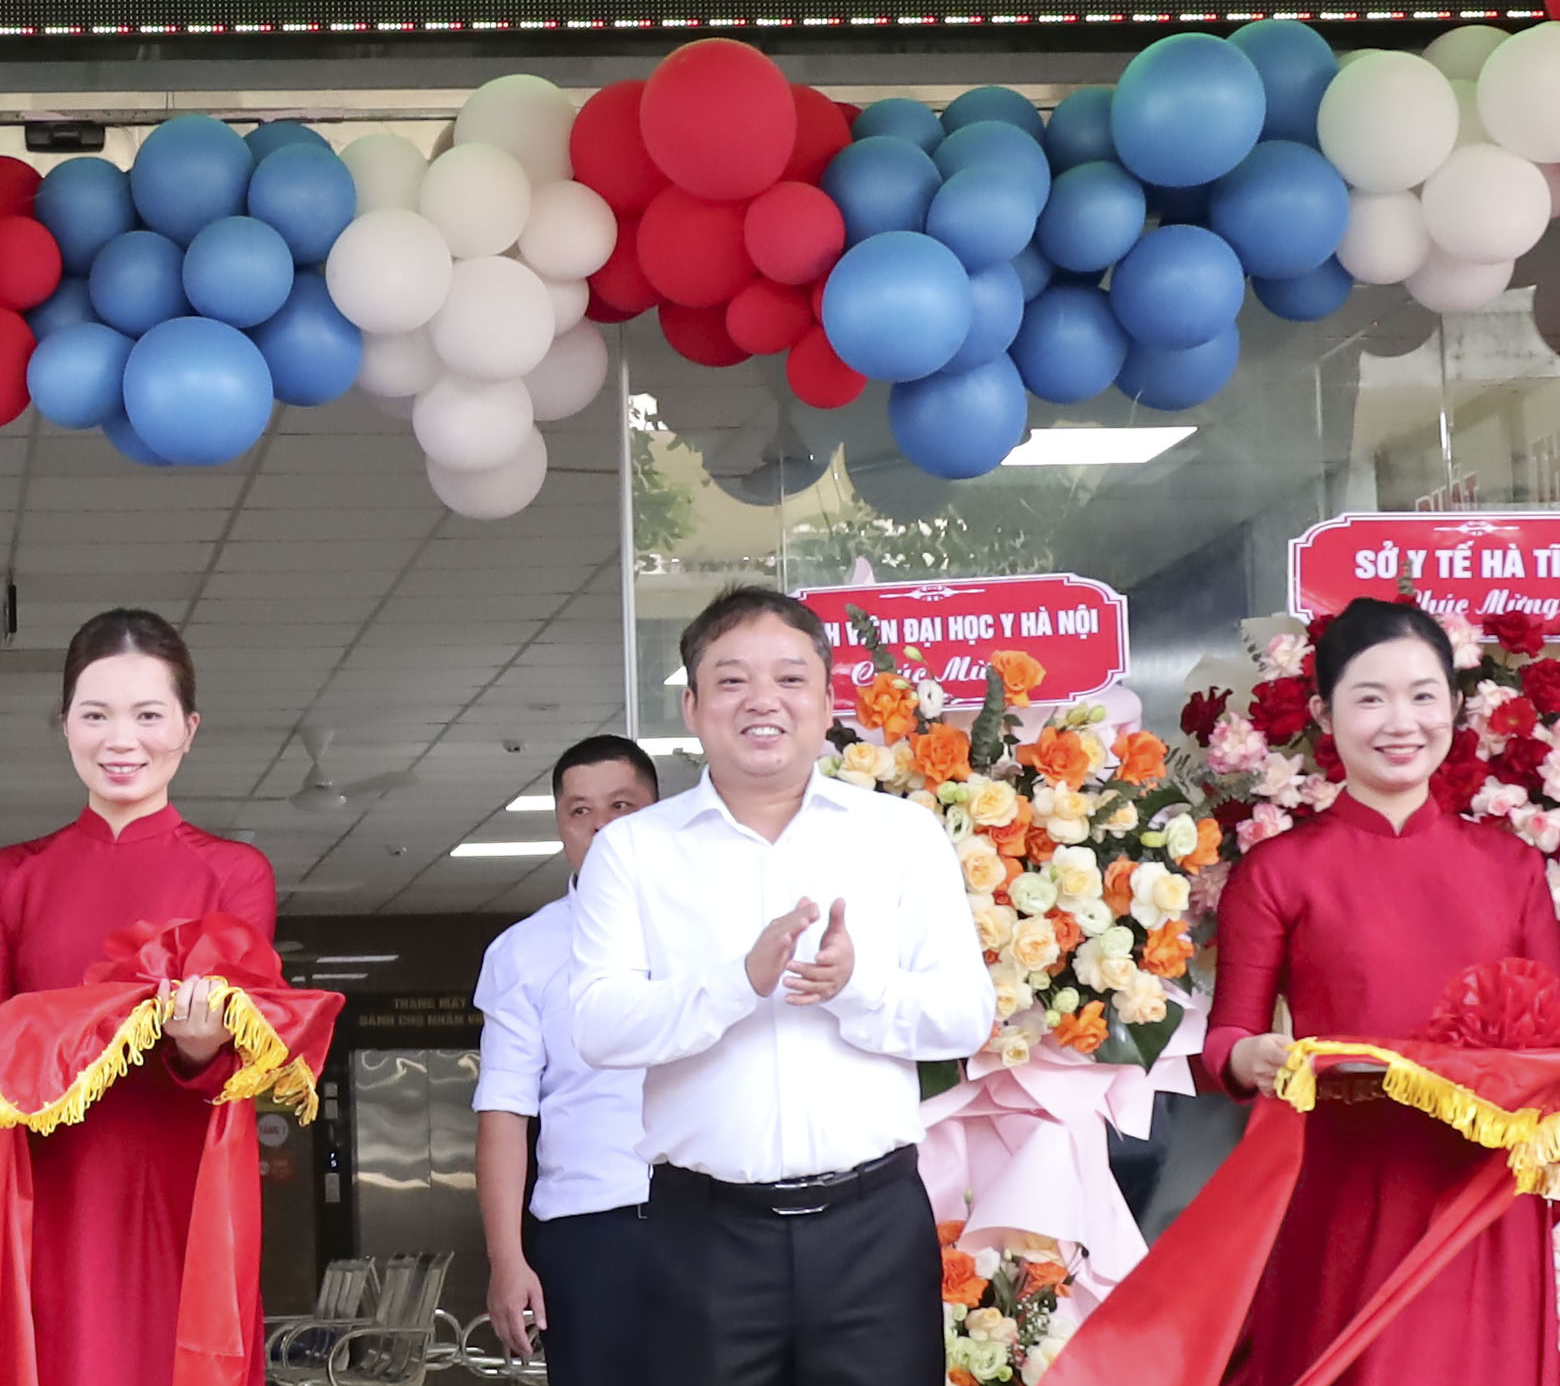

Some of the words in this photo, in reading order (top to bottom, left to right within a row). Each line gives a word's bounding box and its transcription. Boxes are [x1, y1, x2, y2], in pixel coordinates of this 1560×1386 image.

[1355, 540, 1400, 580] SỞ
[1405, 549, 1428, 579] Y
[1435, 540, 1475, 579] TẾ
[1481, 543, 1526, 579] HÀ
[1414, 588, 1470, 614] húc
[903, 616, 942, 648] ĐẠI
[948, 614, 995, 646] HỌC
[999, 612, 1015, 638] Y
[1020, 605, 1053, 638] HÀ
[1057, 603, 1099, 640] NỘI
